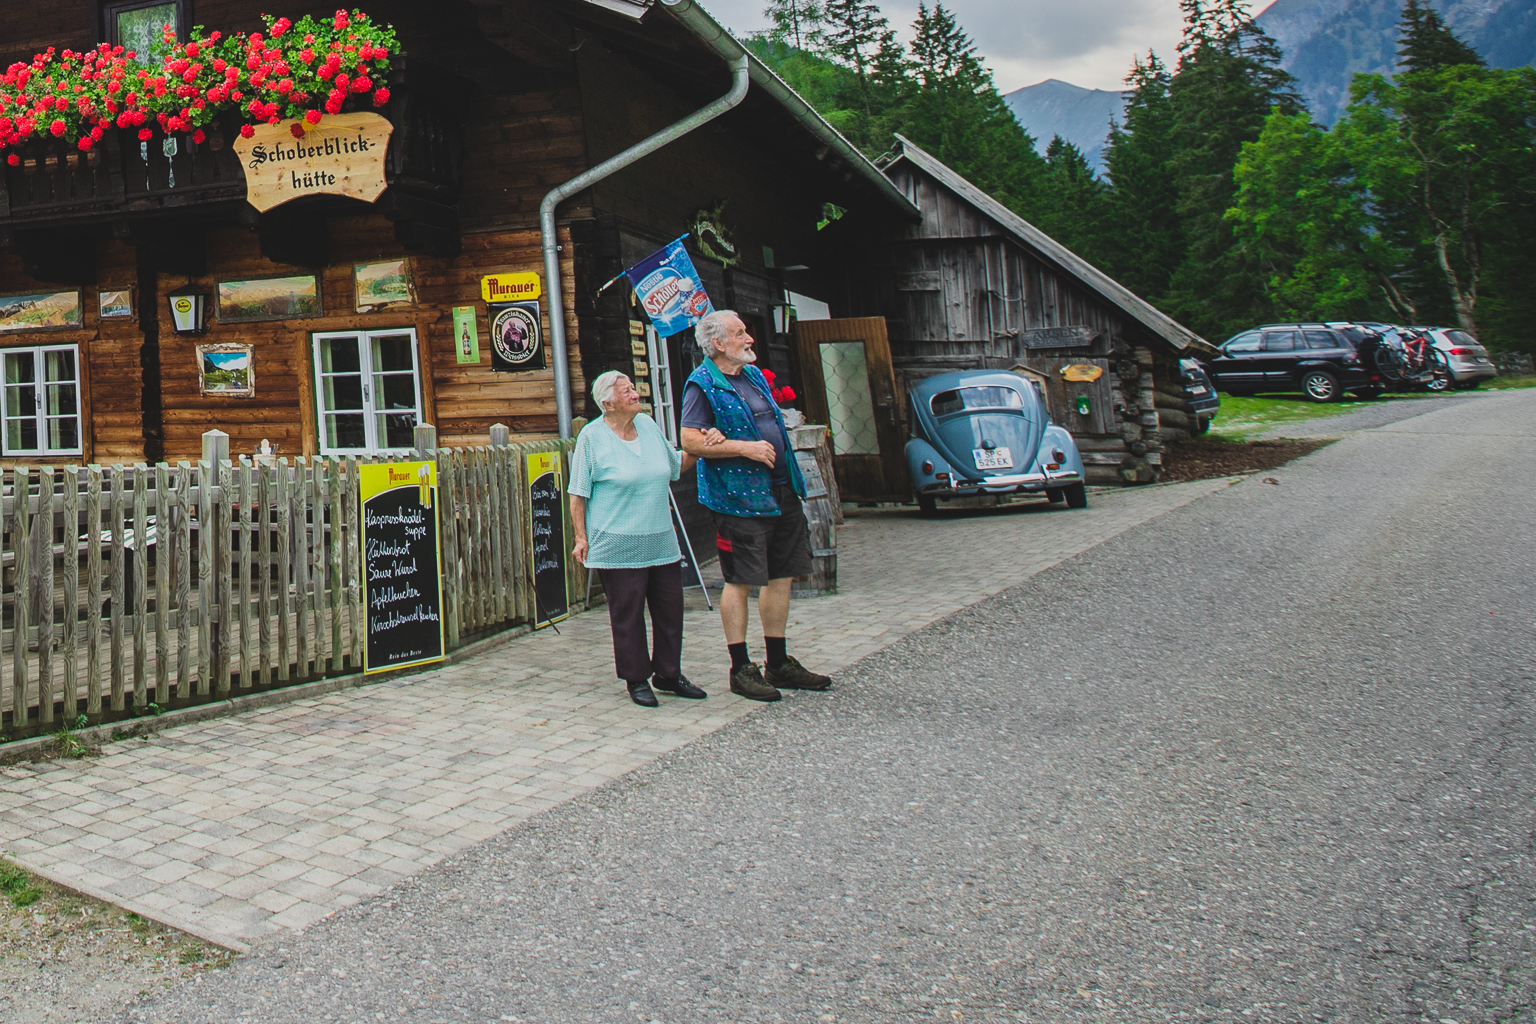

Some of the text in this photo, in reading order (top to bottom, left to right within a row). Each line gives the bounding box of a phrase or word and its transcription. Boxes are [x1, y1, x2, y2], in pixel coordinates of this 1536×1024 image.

[249, 134, 376, 168] Schoberblick-
[292, 171, 336, 189] hütte
[487, 278, 535, 299] Murauer
[645, 278, 679, 316] Schöller
[392, 557, 418, 577] Wurst
[371, 581, 421, 611] Apfelkuchen
